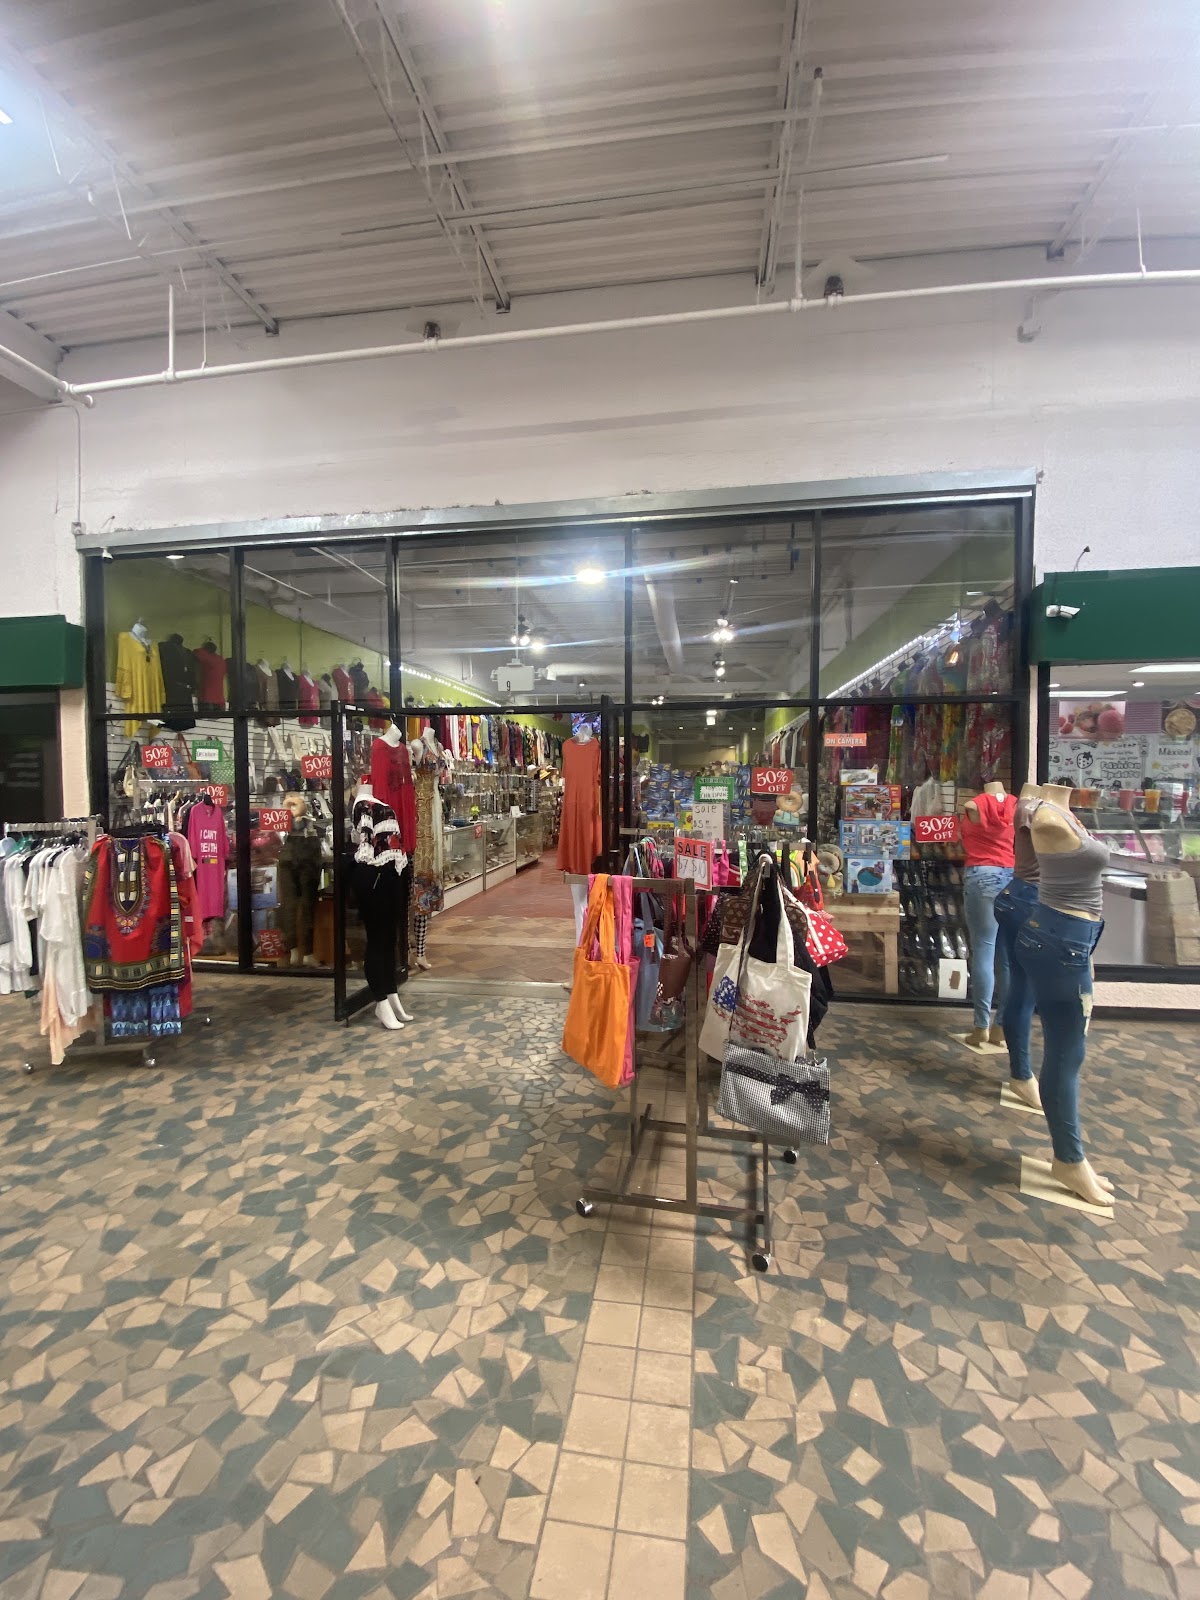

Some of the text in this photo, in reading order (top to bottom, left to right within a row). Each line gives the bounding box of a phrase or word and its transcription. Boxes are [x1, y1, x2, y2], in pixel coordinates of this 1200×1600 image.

[145, 747, 169, 763] 50%
[154, 759, 168, 767] OFF
[305, 756, 331, 773] 50%
[316, 768, 331, 777] OFF
[756, 770, 788, 787] 50%
[768, 783, 787, 793] OFF
[262, 811, 289, 826] 30%
[273, 822, 288, 830] OFF
[919, 817, 955, 835] 30%
[933, 831, 953, 840] OFF
[678, 841, 706, 859] SALE
